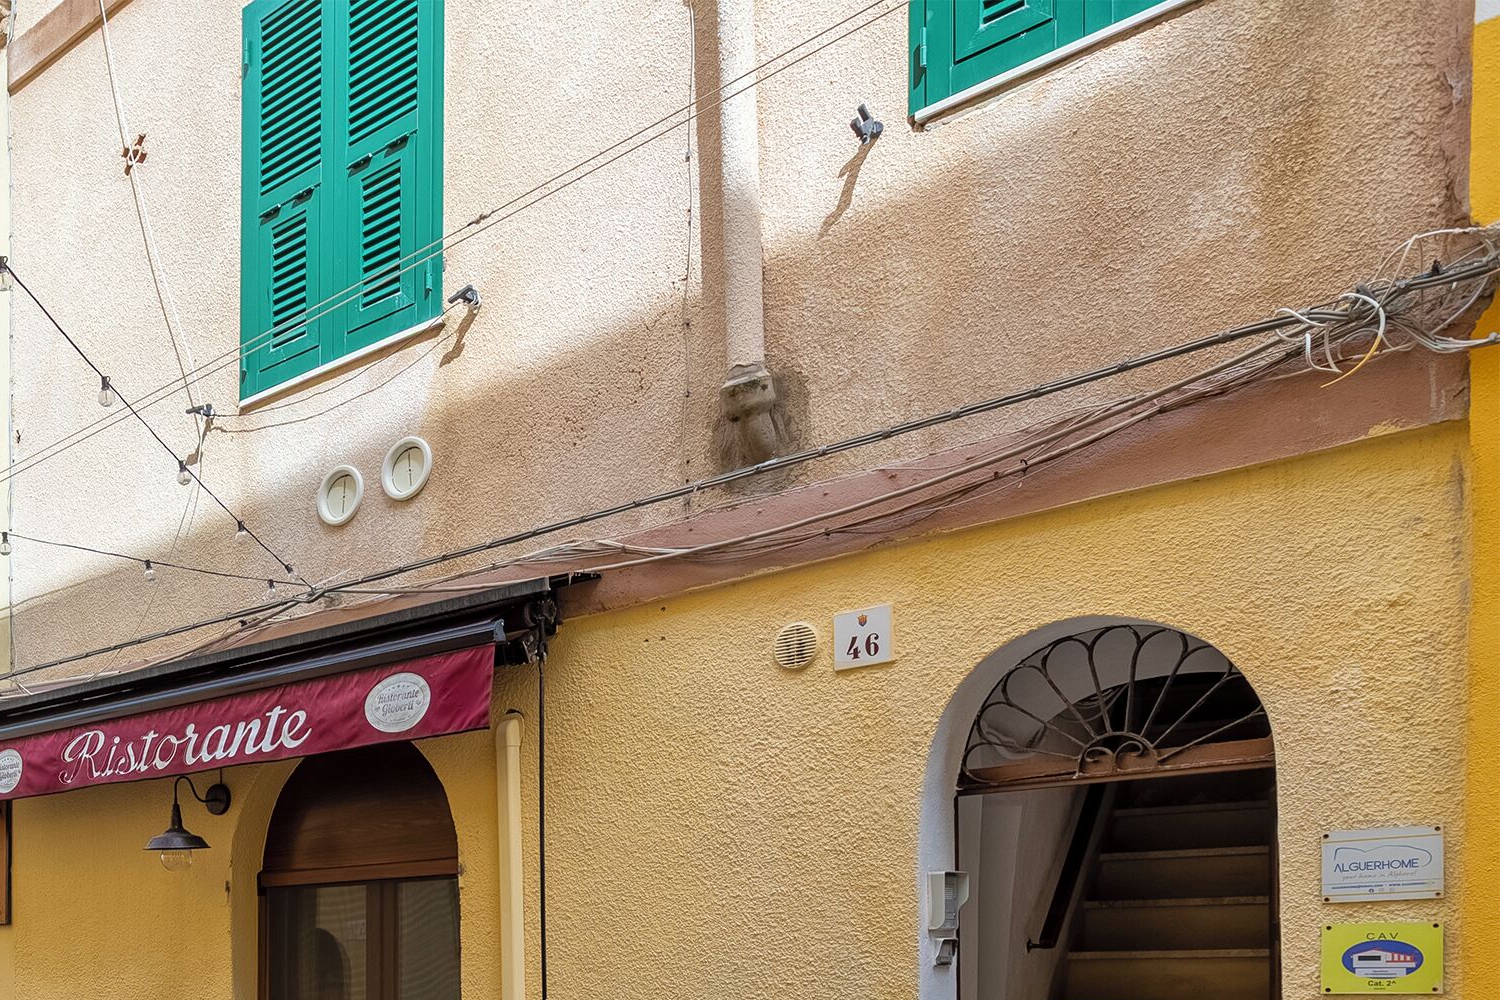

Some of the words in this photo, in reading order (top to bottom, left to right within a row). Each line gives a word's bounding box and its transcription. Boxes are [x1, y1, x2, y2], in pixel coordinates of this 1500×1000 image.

[846, 632, 880, 660] 46
[378, 688, 420, 704] Ristorante
[58, 705, 312, 785] Ristorante
[1333, 857, 1420, 873] ALGUERHOME
[1366, 932, 1399, 940] CAV
